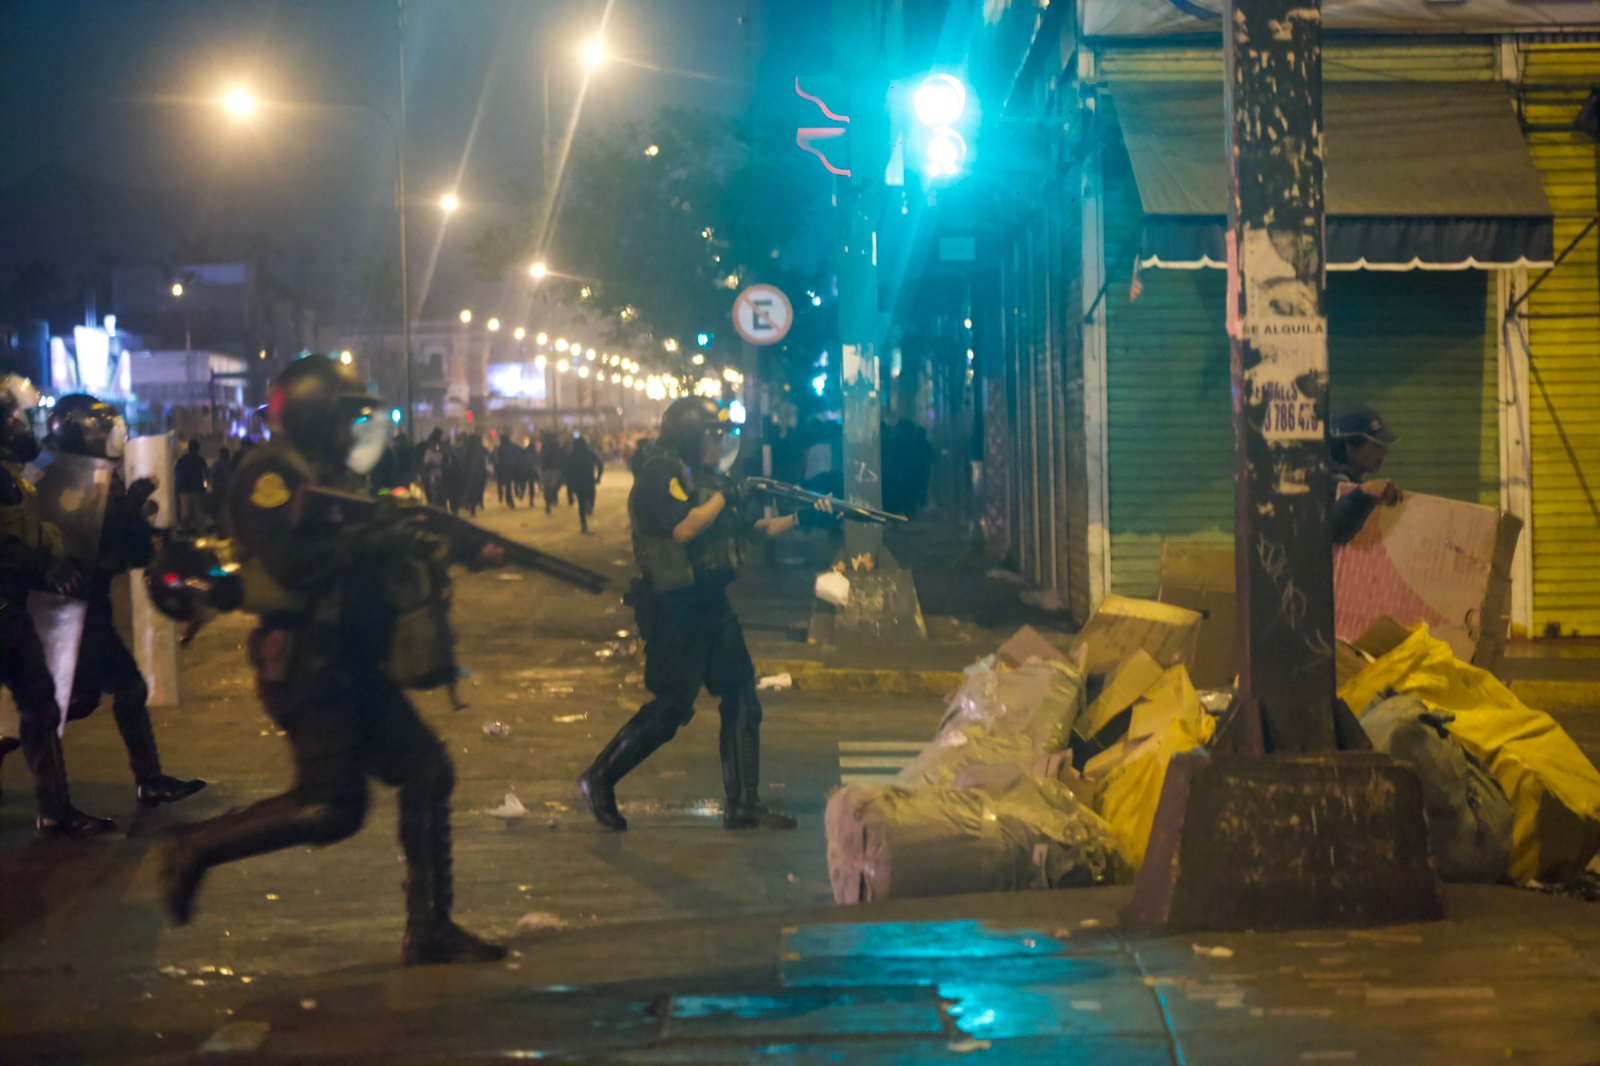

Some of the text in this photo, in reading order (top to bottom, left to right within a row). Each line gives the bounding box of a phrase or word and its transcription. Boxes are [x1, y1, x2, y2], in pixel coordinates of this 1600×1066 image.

[752, 299, 773, 330] E
[1264, 322, 1324, 335] ALQUILA
[1274, 402, 1295, 432] 786
